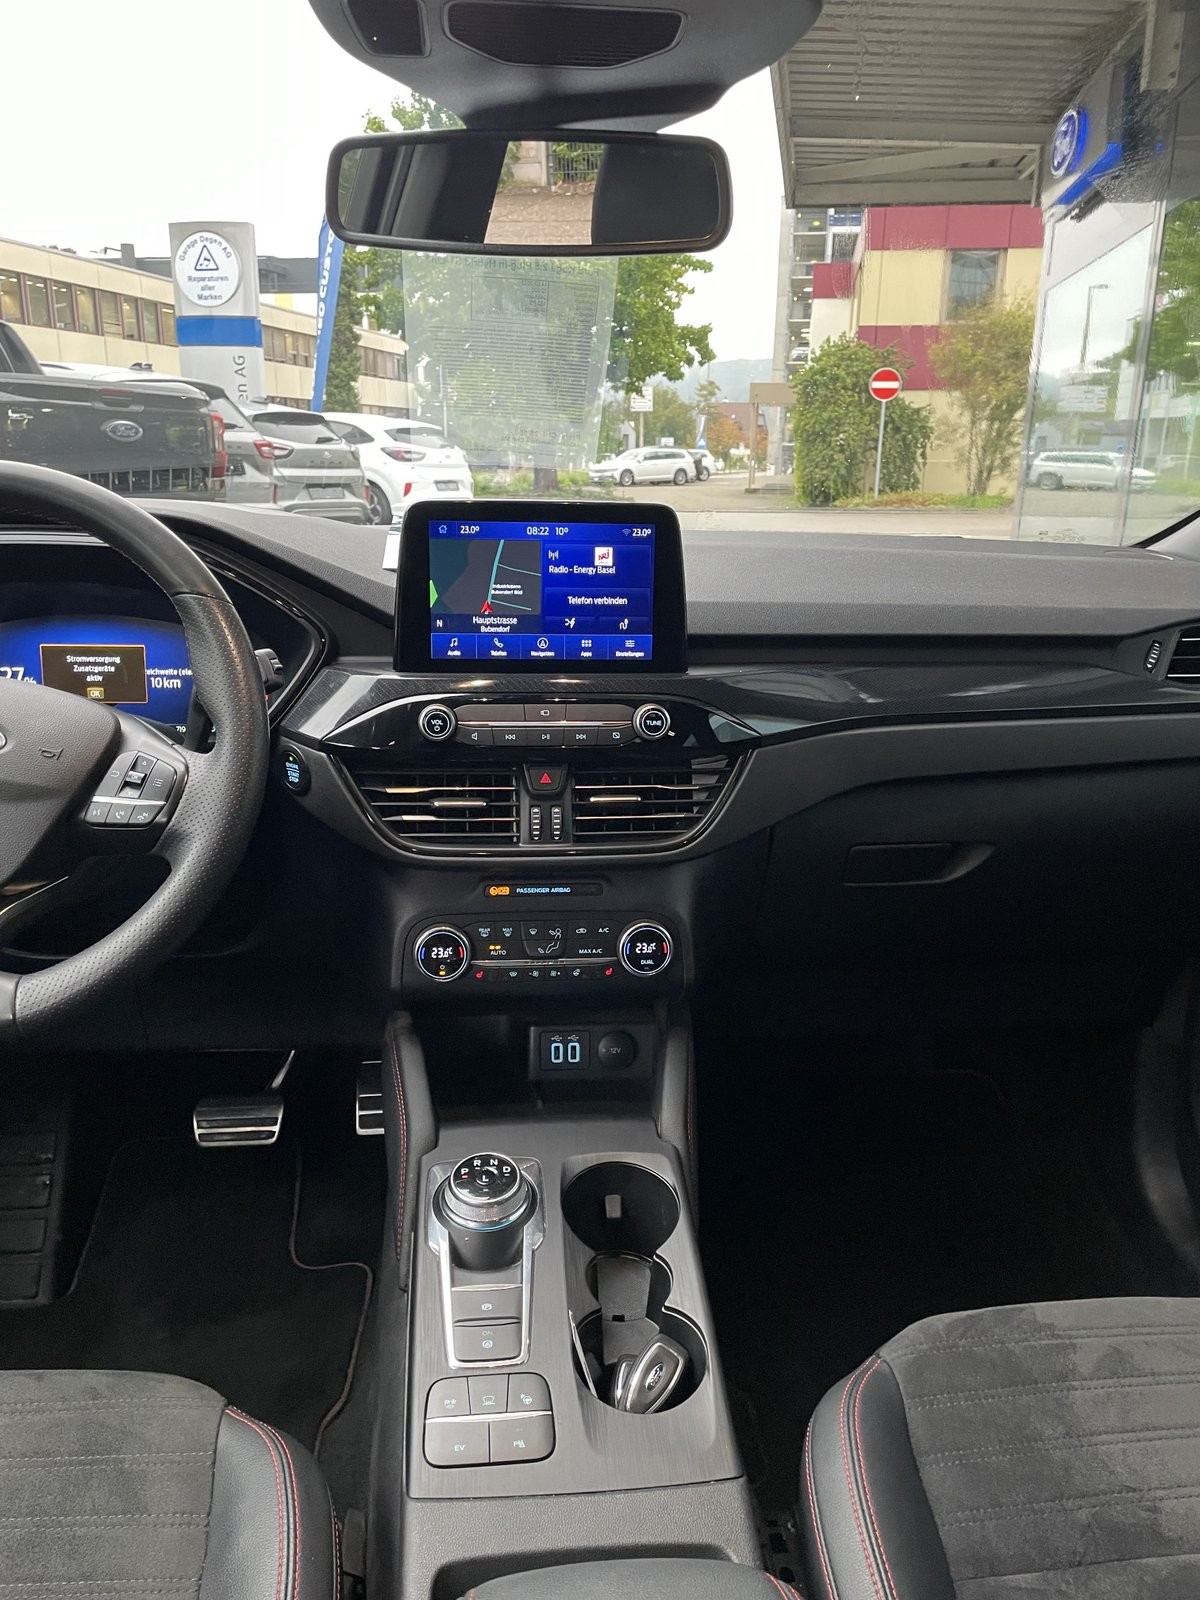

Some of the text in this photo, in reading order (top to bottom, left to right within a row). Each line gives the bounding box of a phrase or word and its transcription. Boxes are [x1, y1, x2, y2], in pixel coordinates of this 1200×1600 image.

[222, 246, 232, 259] AG
[187, 275, 229, 283] Reparaturen
[200, 284, 216, 292] aller
[197, 293, 223, 301] Marken
[232, 355, 247, 378] AG
[526, 526, 549, 536] 08:22
[548, 565, 569, 574] Radio
[573, 565, 596, 575] Energy
[597, 565, 616, 574] Basel
[567, 596, 628, 605] Telefon verbinden
[436, 619, 443, 628] N
[472, 616, 518, 625] Hauptstrasse
[480, 625, 511, 633] Bubendorf
[66, 655, 121, 664] Stromversorgung
[73, 664, 115, 673] Zusatzgeräte
[86, 674, 104, 682] aktiv
[150, 677, 182, 689] 10 km
[90, 690, 101, 698] OK
[473, 1159, 482, 1167] R
[490, 1158, 499, 1166] N
[482, 1174, 490, 1182] L
[454, 1444, 466, 1452] EV
